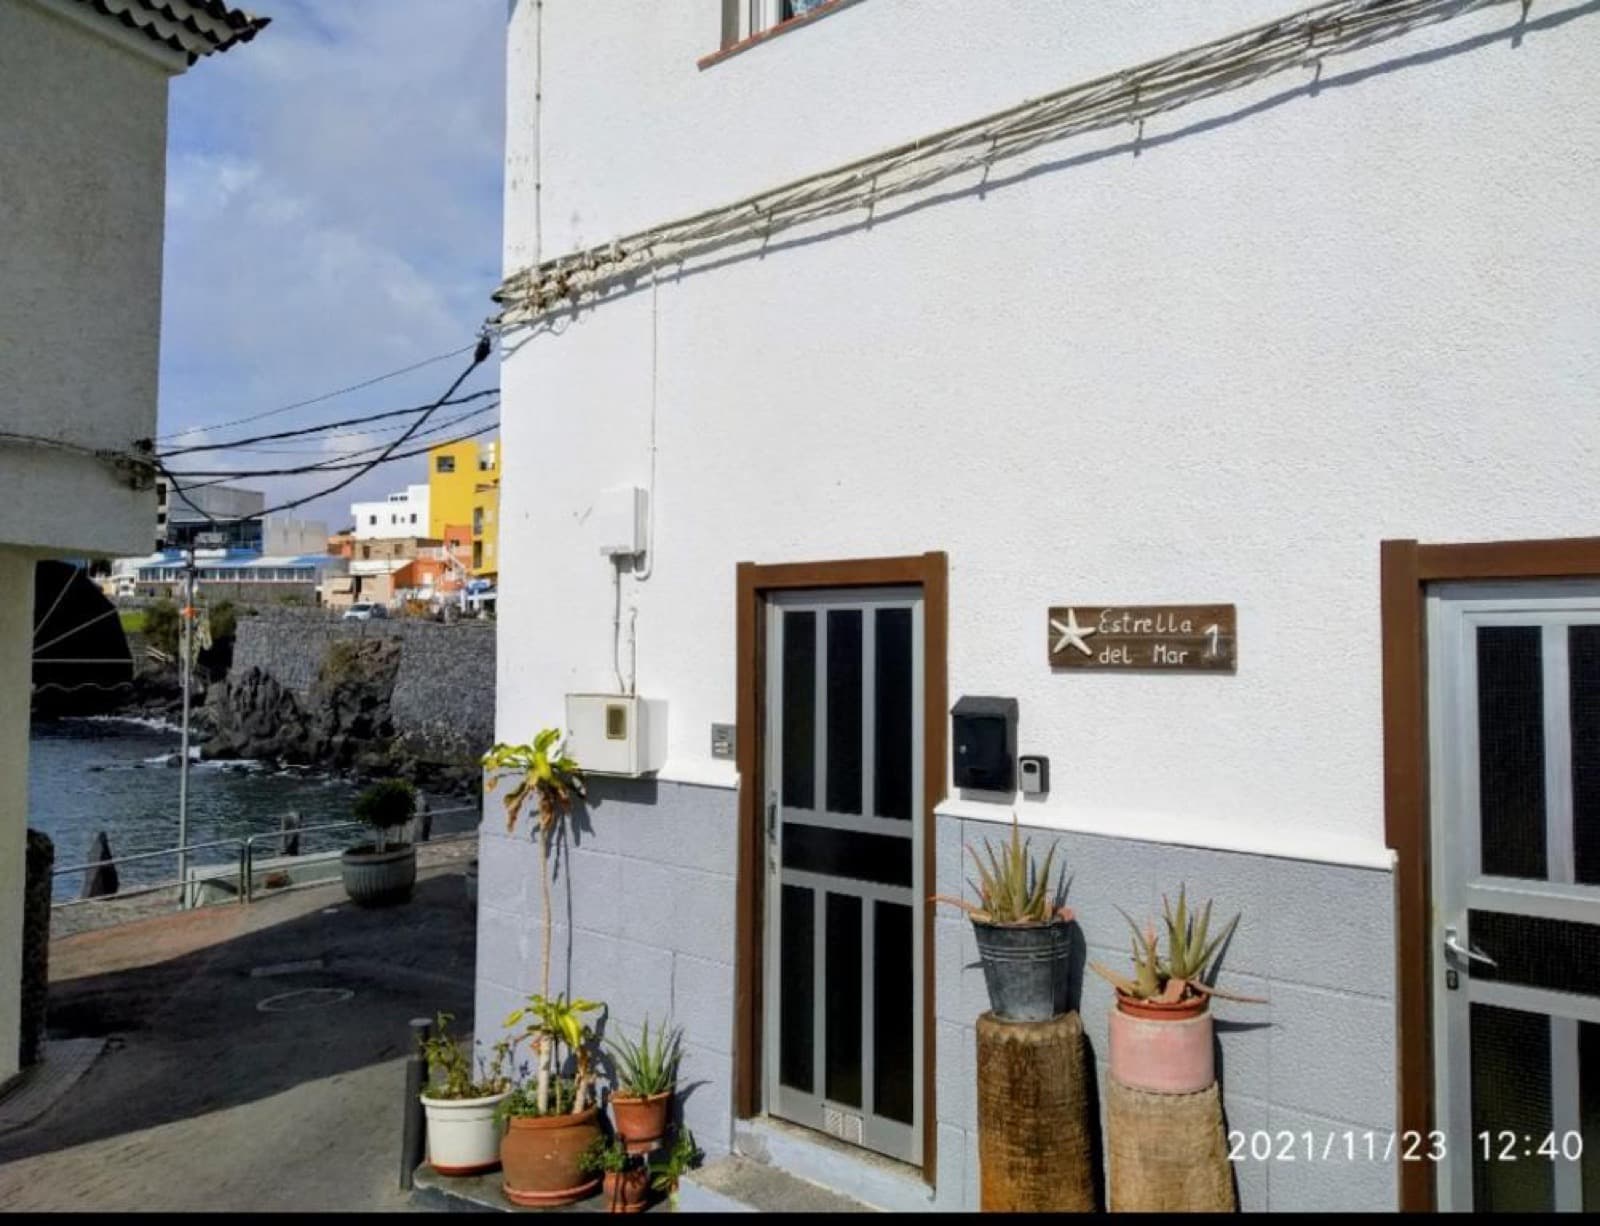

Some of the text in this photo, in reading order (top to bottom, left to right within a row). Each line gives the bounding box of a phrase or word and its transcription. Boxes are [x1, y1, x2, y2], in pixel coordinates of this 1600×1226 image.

[1099, 608, 1192, 633] Estrella
[1204, 623, 1218, 656] 1
[1099, 644, 1189, 664] del Mar
